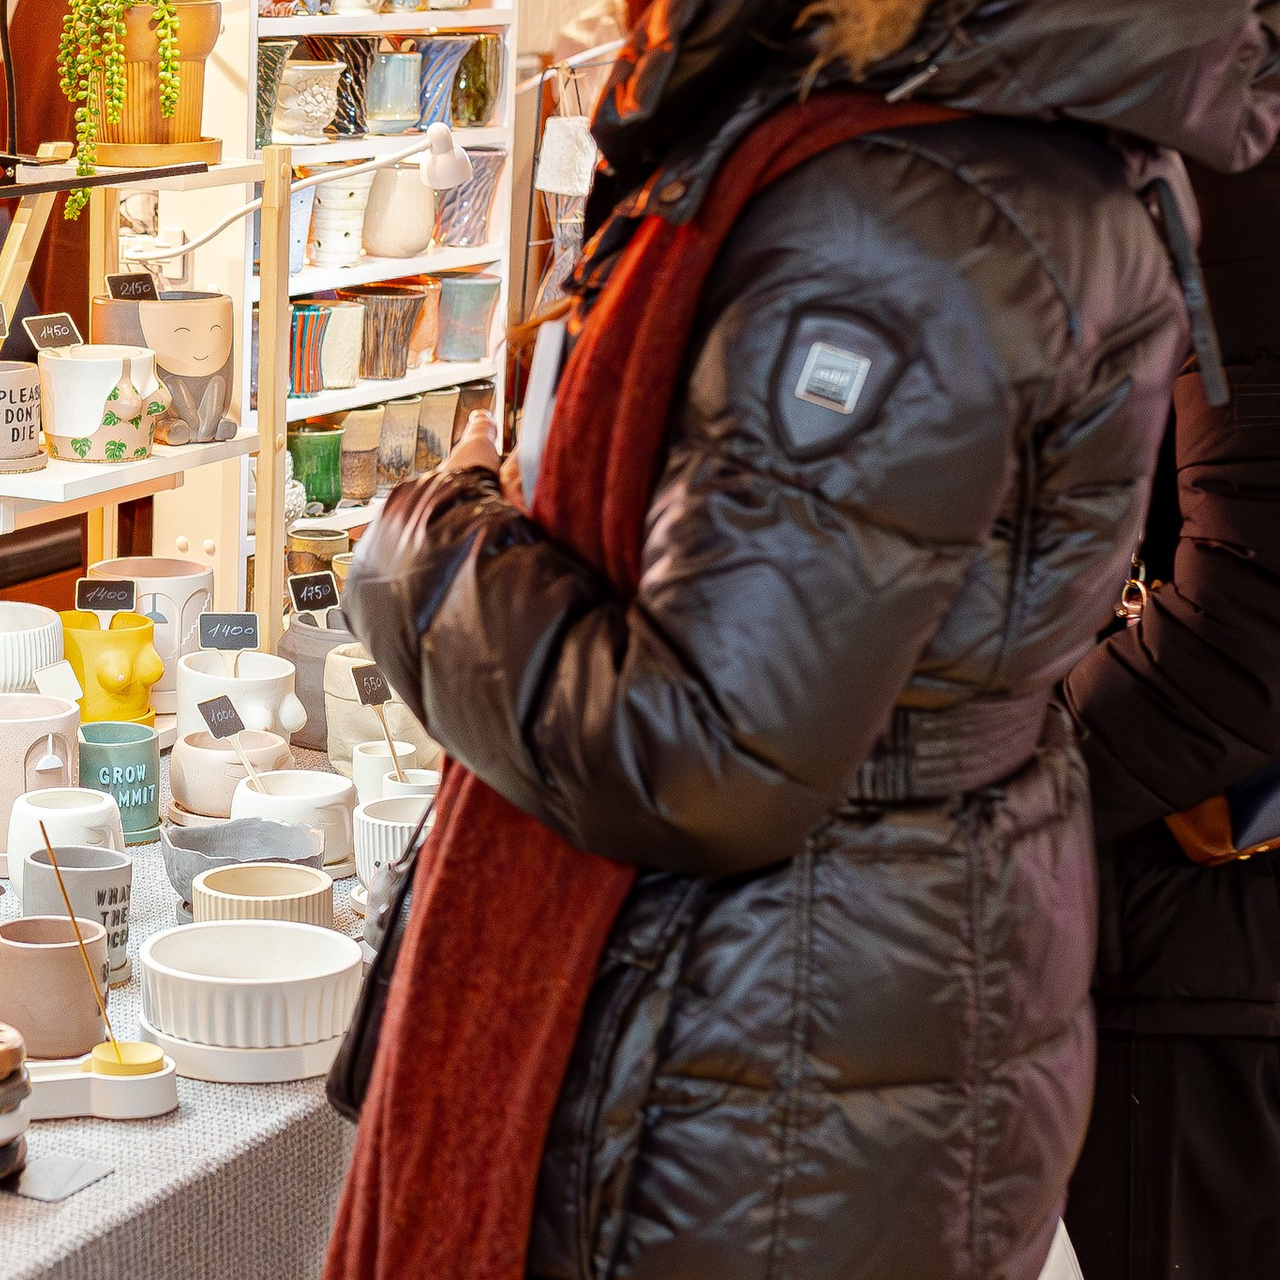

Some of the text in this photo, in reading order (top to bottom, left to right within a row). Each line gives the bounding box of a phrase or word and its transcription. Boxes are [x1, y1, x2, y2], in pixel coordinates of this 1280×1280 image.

[120, 281, 151, 296] 2150
[40, 325, 70, 340] 1450
[11, 424, 35, 443] DIE
[86, 587, 128, 602] 1400
[300, 585, 331, 602] 1750
[208, 624, 255, 638] 1400
[363, 676, 382, 694] 550
[99, 764, 146, 785] GROW
[101, 907, 128, 927] THE
